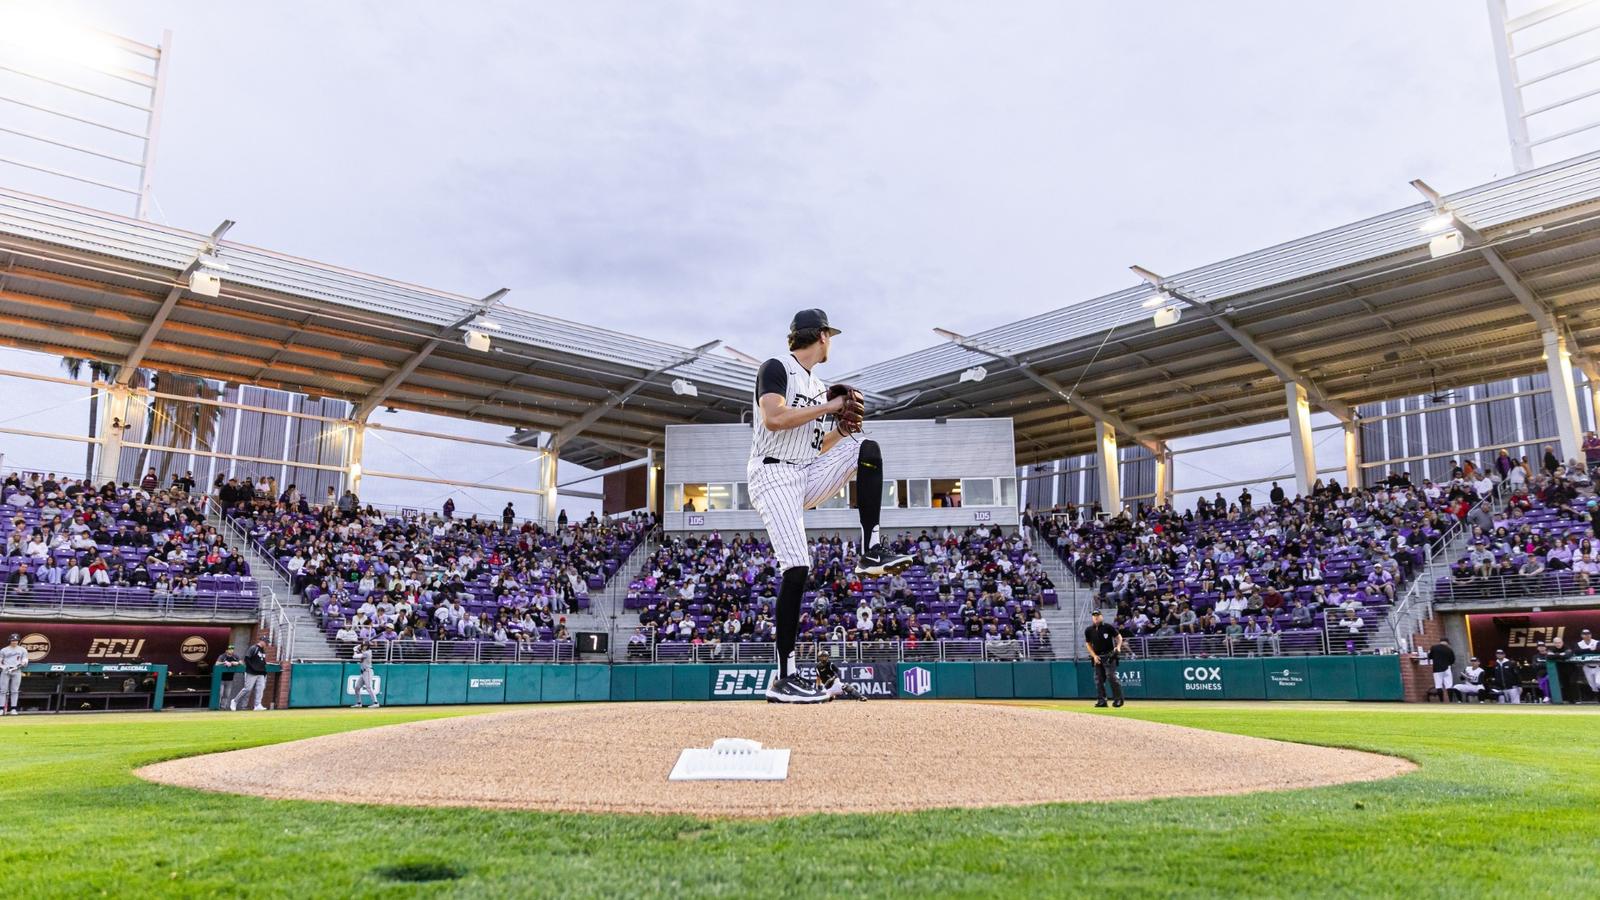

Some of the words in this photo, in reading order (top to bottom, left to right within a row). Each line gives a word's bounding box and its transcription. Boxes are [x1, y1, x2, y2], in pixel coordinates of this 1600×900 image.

[690, 516, 704, 525] 105
[975, 511, 990, 520] 105
[87, 638, 146, 658] GCU
[183, 644, 207, 653] PEPSI
[589, 634, 598, 651] 7
[1183, 667, 1221, 681] COX
[714, 669, 779, 695] GCU
